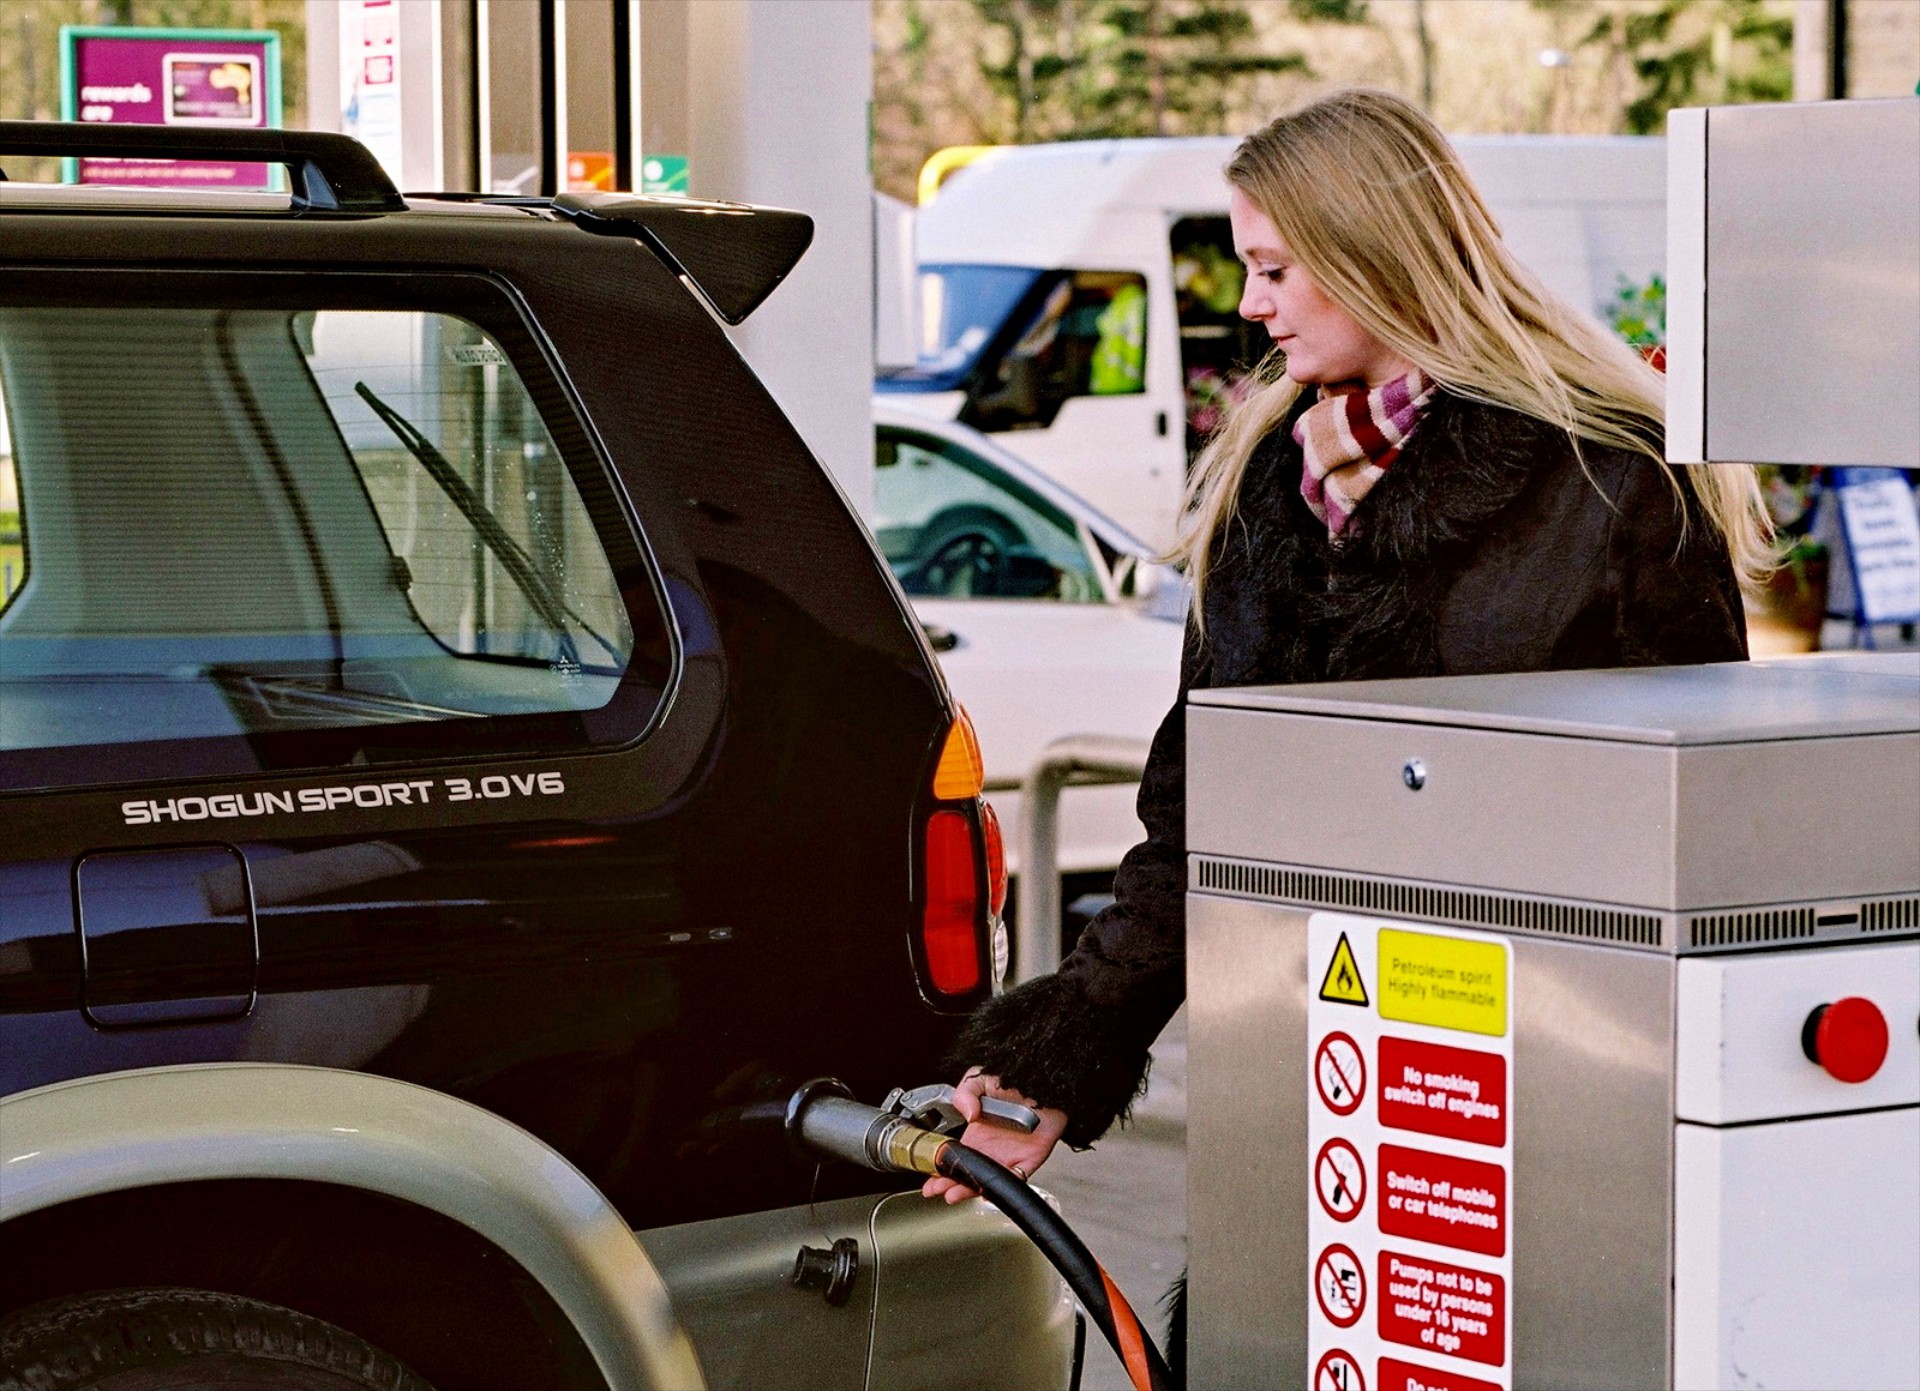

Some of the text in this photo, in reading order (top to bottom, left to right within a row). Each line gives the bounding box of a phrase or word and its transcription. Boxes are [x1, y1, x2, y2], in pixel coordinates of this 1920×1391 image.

[122, 791, 294, 825] SHOGUN
[299, 781, 433, 812] SPORT
[1392, 957, 1492, 986] Petroleum spirit
[1388, 978, 1496, 1007] Highly flammable
[1403, 1065, 1479, 1102] No smoking
[1384, 1085, 1500, 1120] switch off engines
[1387, 1170, 1496, 1209] Switch off mobile
[1388, 1195, 1498, 1230] or car telephones
[1390, 1258, 1493, 1297] Pumps not to be
[1389, 1281, 1494, 1318] used by persons
[1394, 1302, 1488, 1337] under 16 years
[1420, 1327, 1461, 1352] of age
